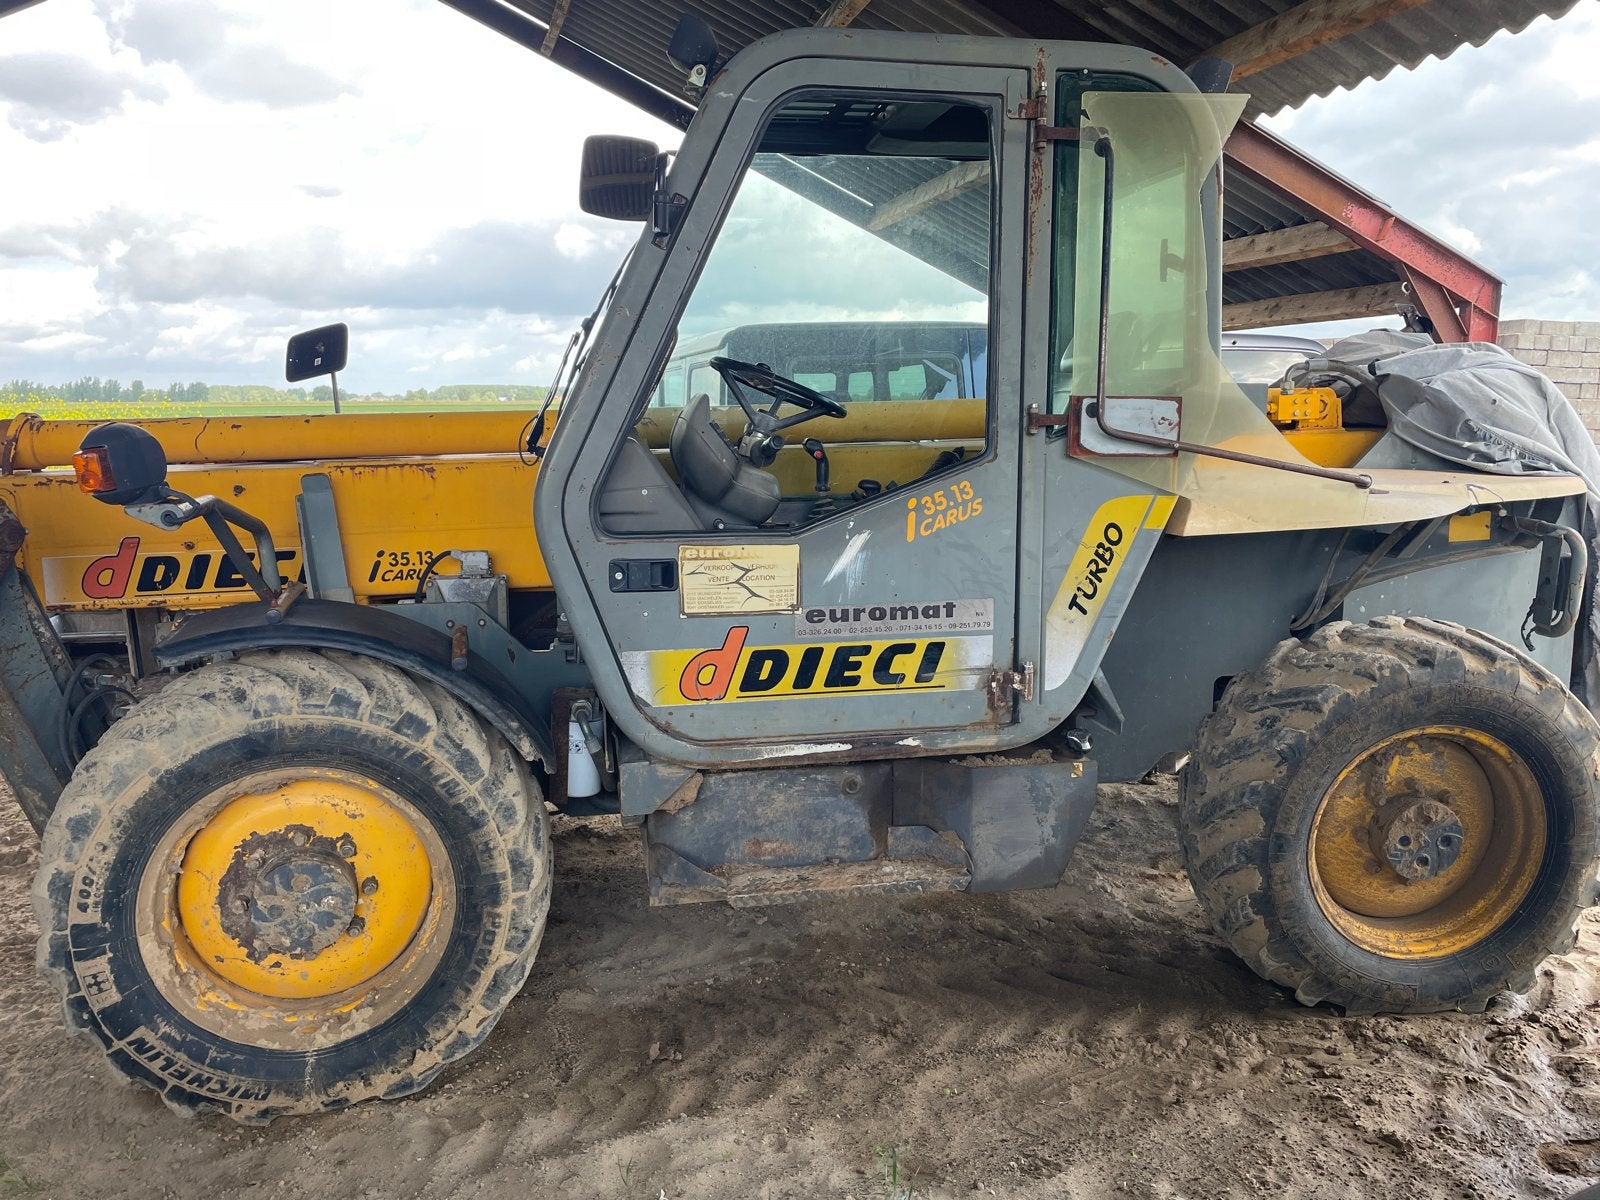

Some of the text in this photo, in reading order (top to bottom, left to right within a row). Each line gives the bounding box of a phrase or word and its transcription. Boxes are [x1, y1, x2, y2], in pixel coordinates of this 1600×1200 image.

[921, 480, 974, 515] 35.13
[136, 550, 308, 592] DIE
[704, 564, 735, 572] VERKOOP
[708, 574, 776, 583] VENTE LOCATION
[1068, 522, 1123, 616] TURBO
[805, 601, 957, 624] euromat
[948, 621, 991, 630] 09-251.79.79
[739, 641, 946, 693] DIECI
[126, 1036, 273, 1102] MICHELIN
